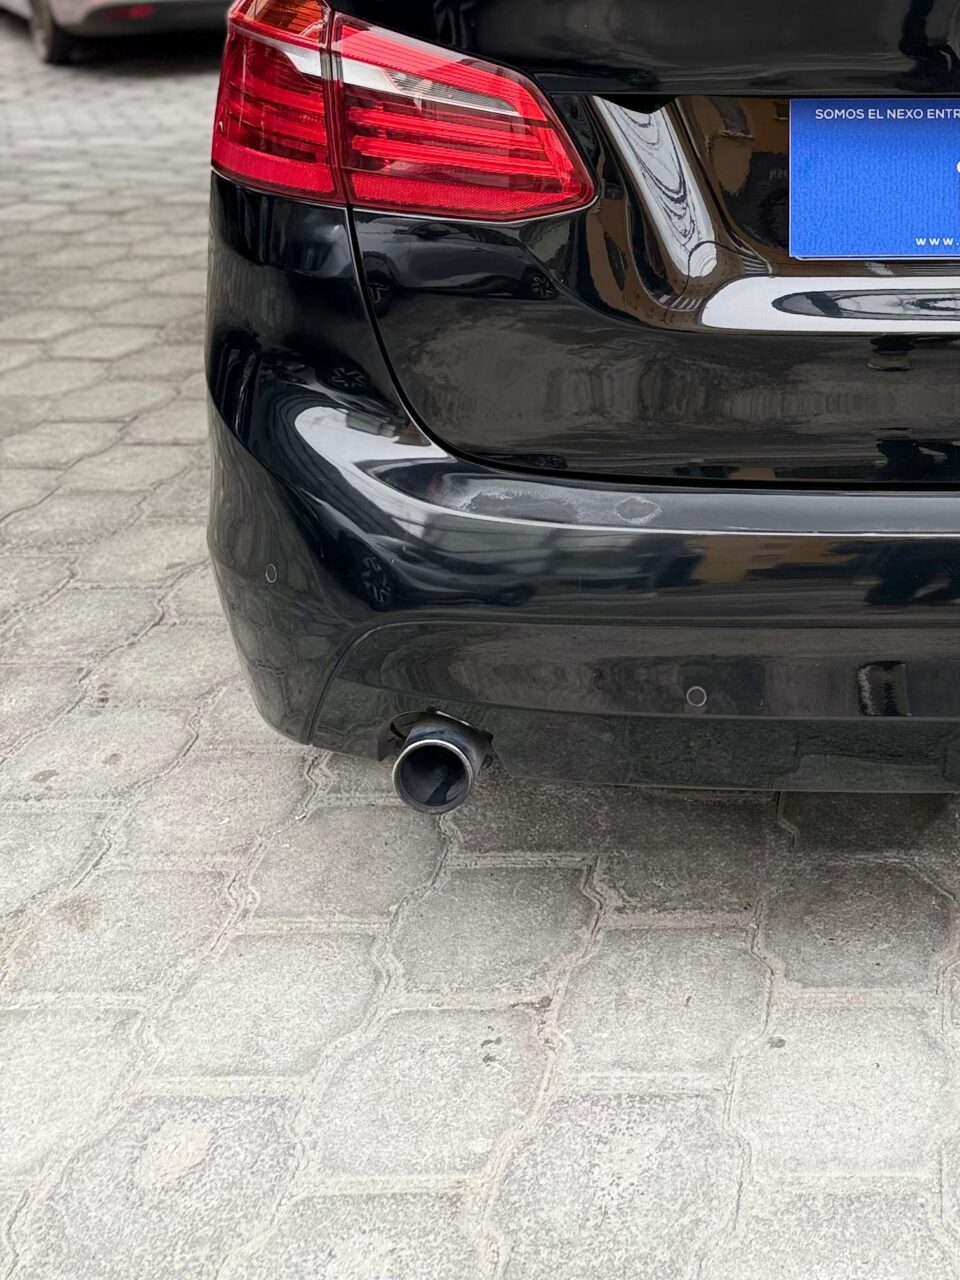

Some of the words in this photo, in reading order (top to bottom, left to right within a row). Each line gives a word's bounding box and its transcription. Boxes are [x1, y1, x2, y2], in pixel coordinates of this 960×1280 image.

[815, 108, 865, 120] SOMOS
[868, 108, 884, 120] EL
[886, 108, 924, 120] NEXO
